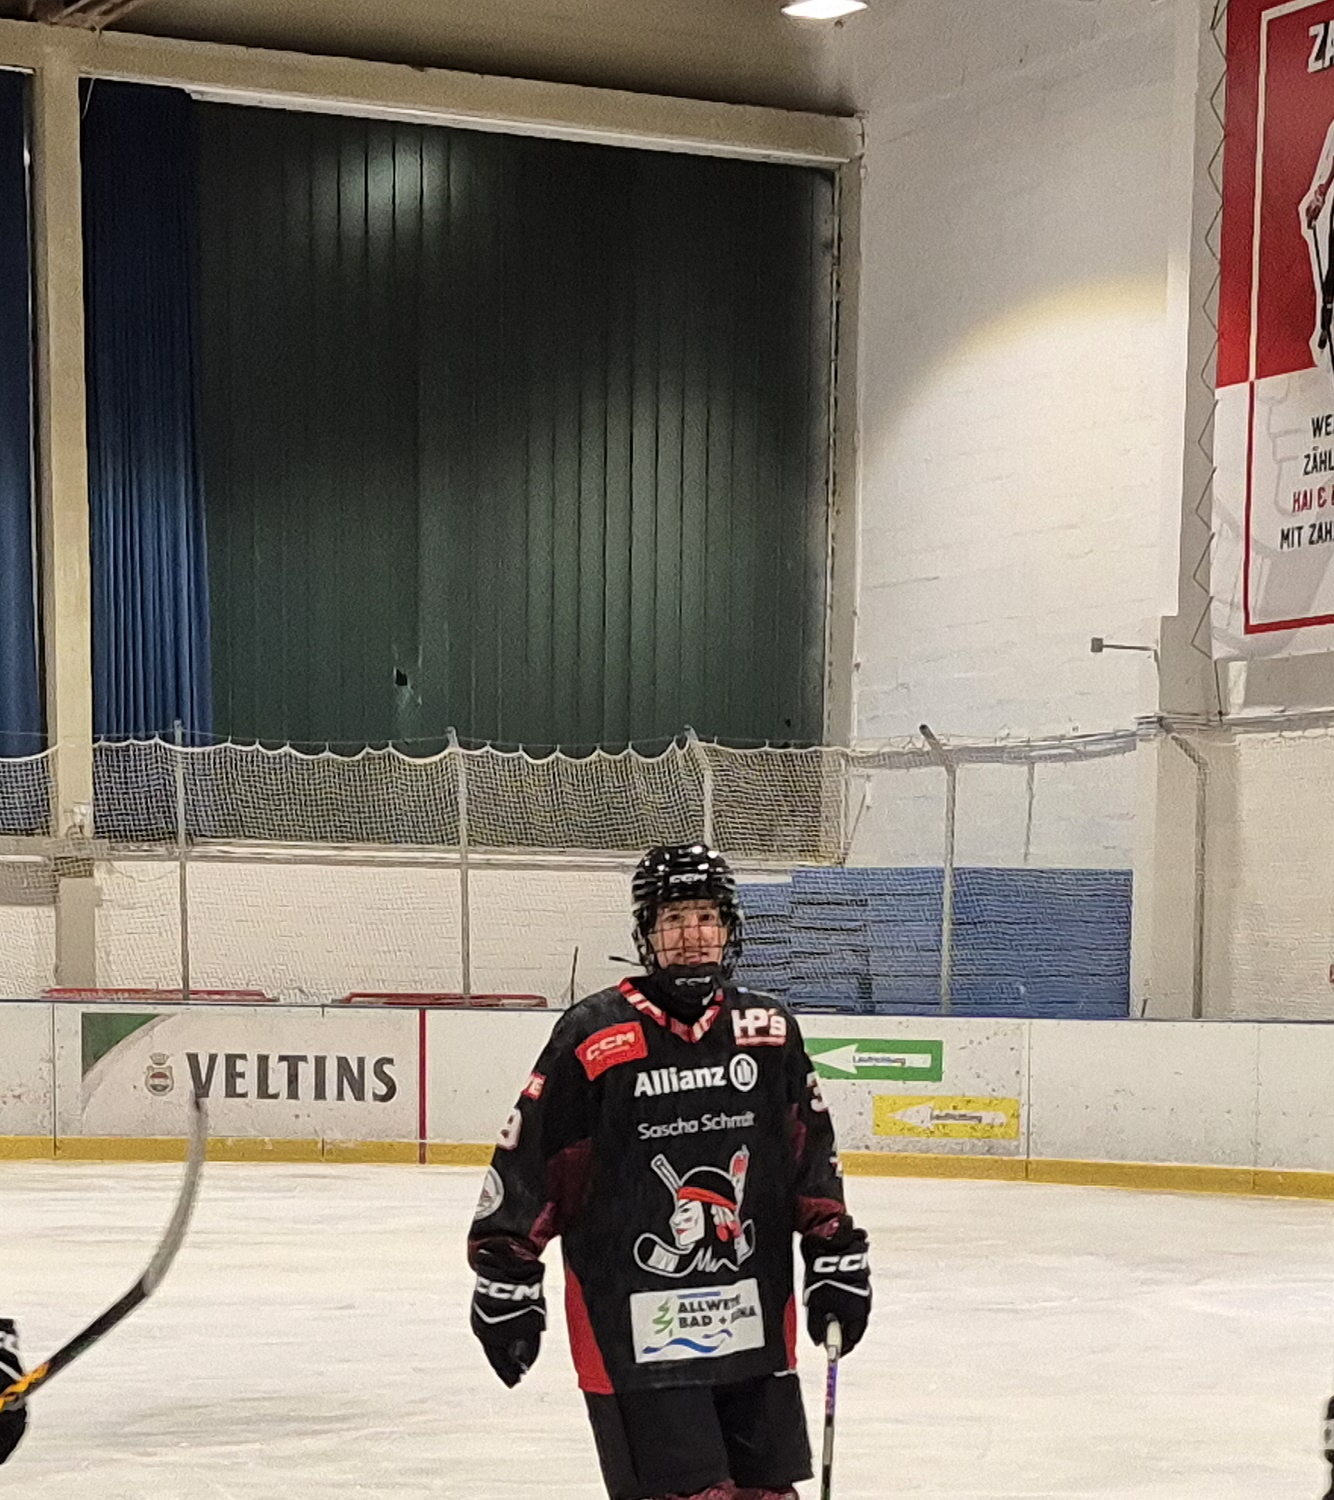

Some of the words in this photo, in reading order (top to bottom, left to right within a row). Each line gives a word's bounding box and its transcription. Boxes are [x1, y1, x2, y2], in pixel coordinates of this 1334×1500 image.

[1280, 526, 1303, 549] MIT
[186, 1052, 398, 1104] VELTINS
[634, 1065, 727, 1098] Allianz
[637, 1114, 700, 1140] Sascha
[678, 1315, 713, 1330] BAD
